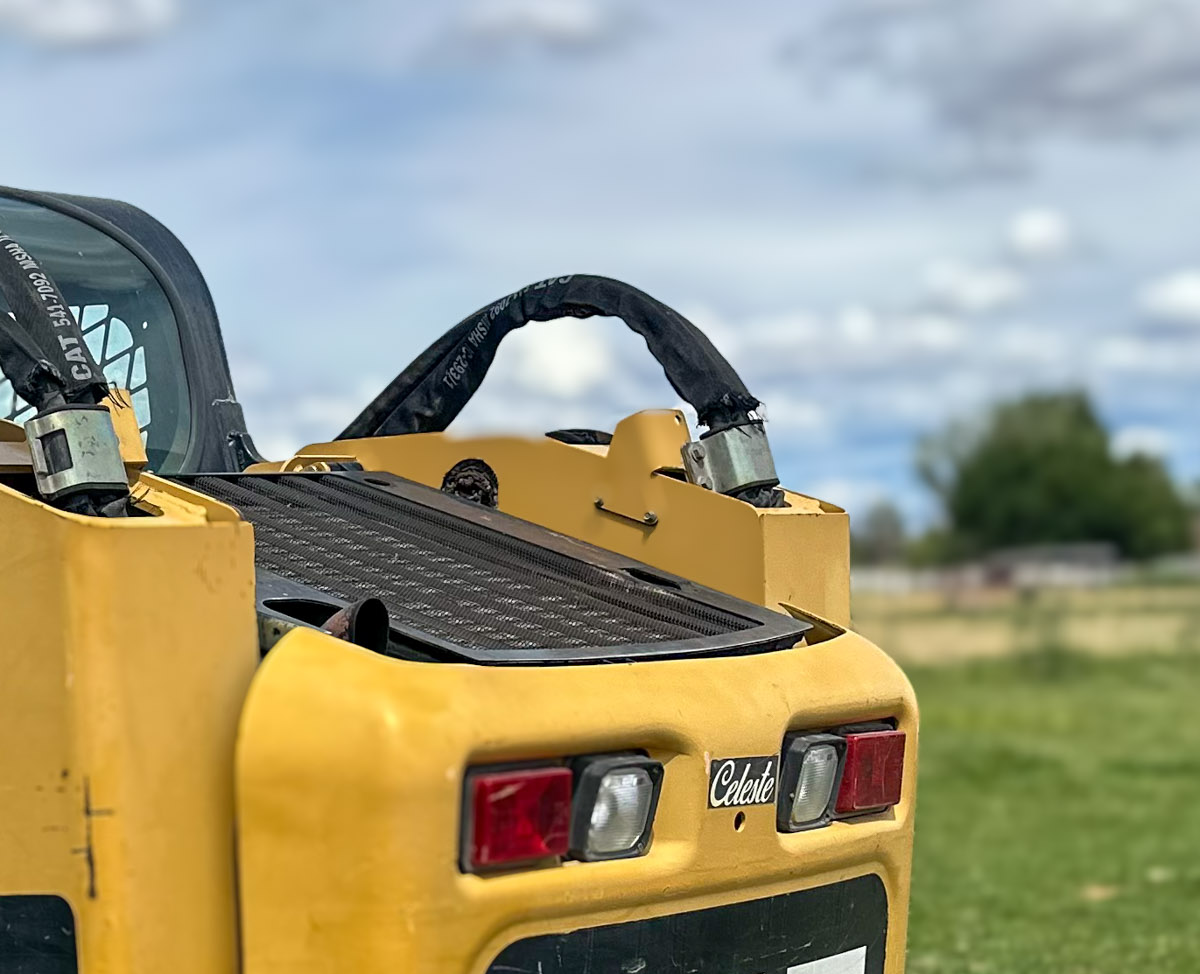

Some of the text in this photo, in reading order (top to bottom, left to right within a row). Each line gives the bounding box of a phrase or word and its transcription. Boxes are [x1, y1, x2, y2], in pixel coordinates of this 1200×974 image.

[28, 271, 71, 328] 541-7092
[57, 334, 92, 381] CAT
[710, 760, 775, 807] Celeste
